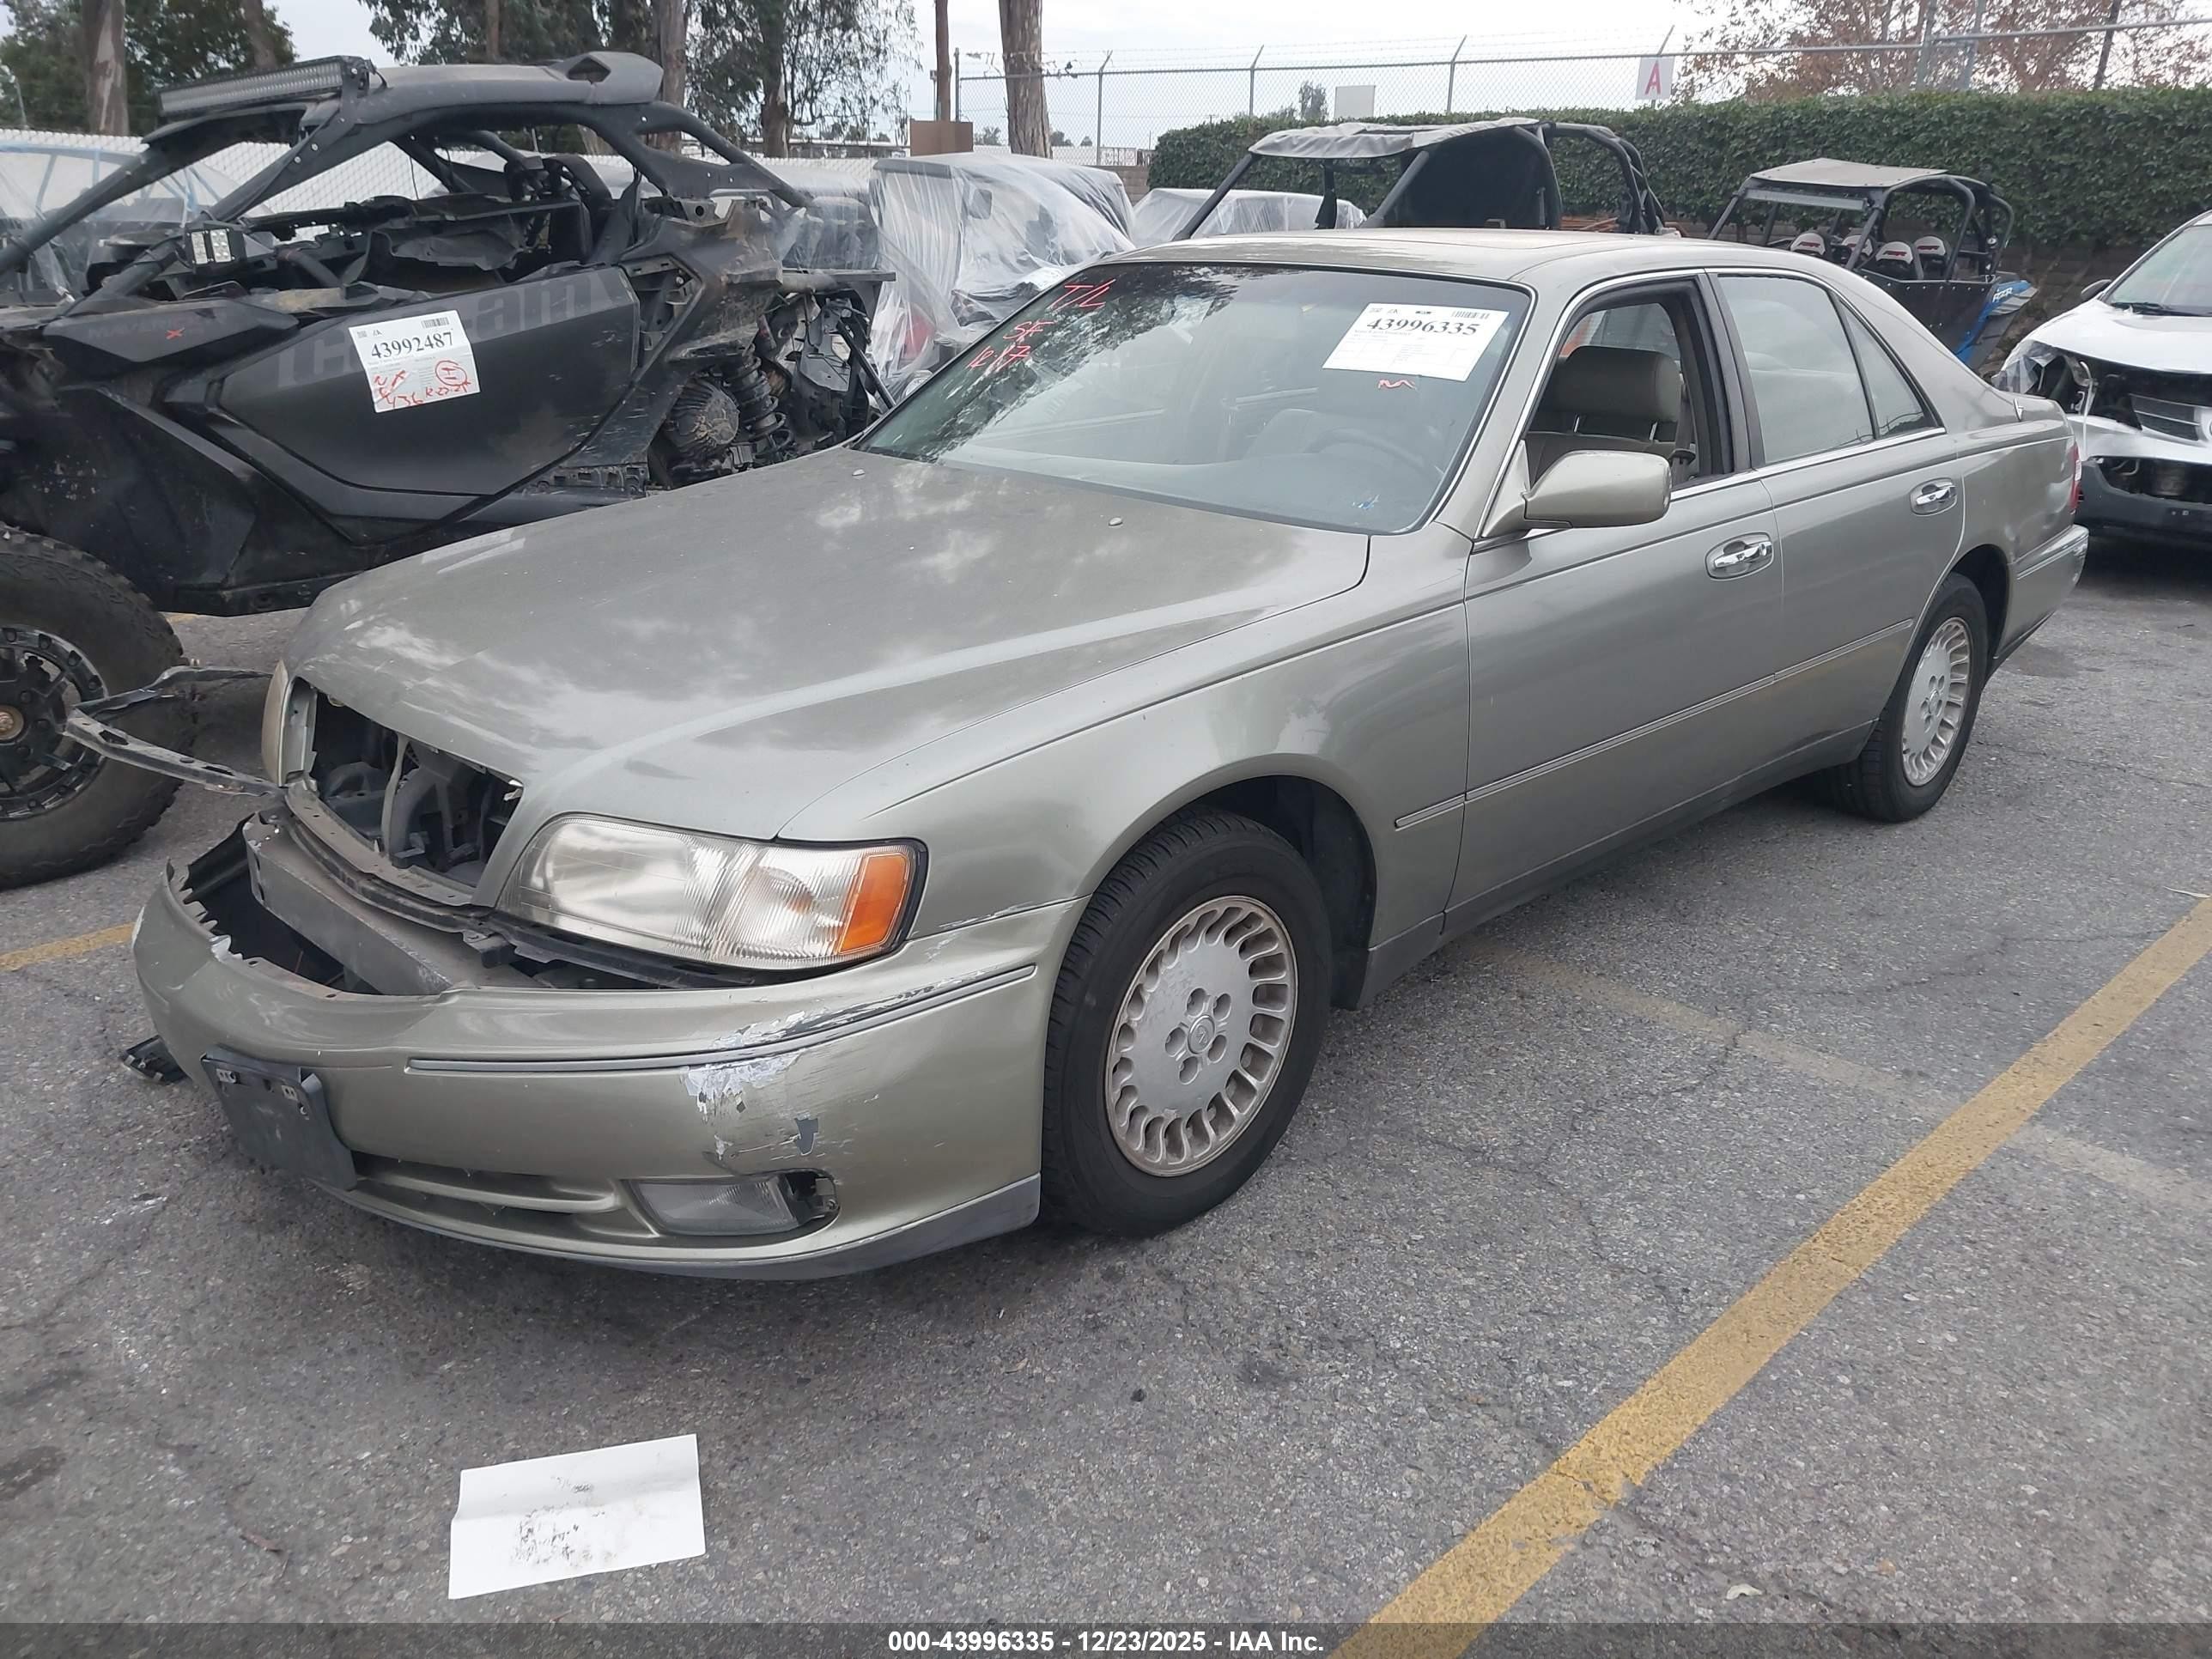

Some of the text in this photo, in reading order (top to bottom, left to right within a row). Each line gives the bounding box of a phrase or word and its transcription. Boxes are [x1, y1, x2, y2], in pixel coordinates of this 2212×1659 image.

[1644, 61, 1662, 94] A
[1367, 318, 1480, 336] 43996335
[371, 331, 453, 359] 43992487
